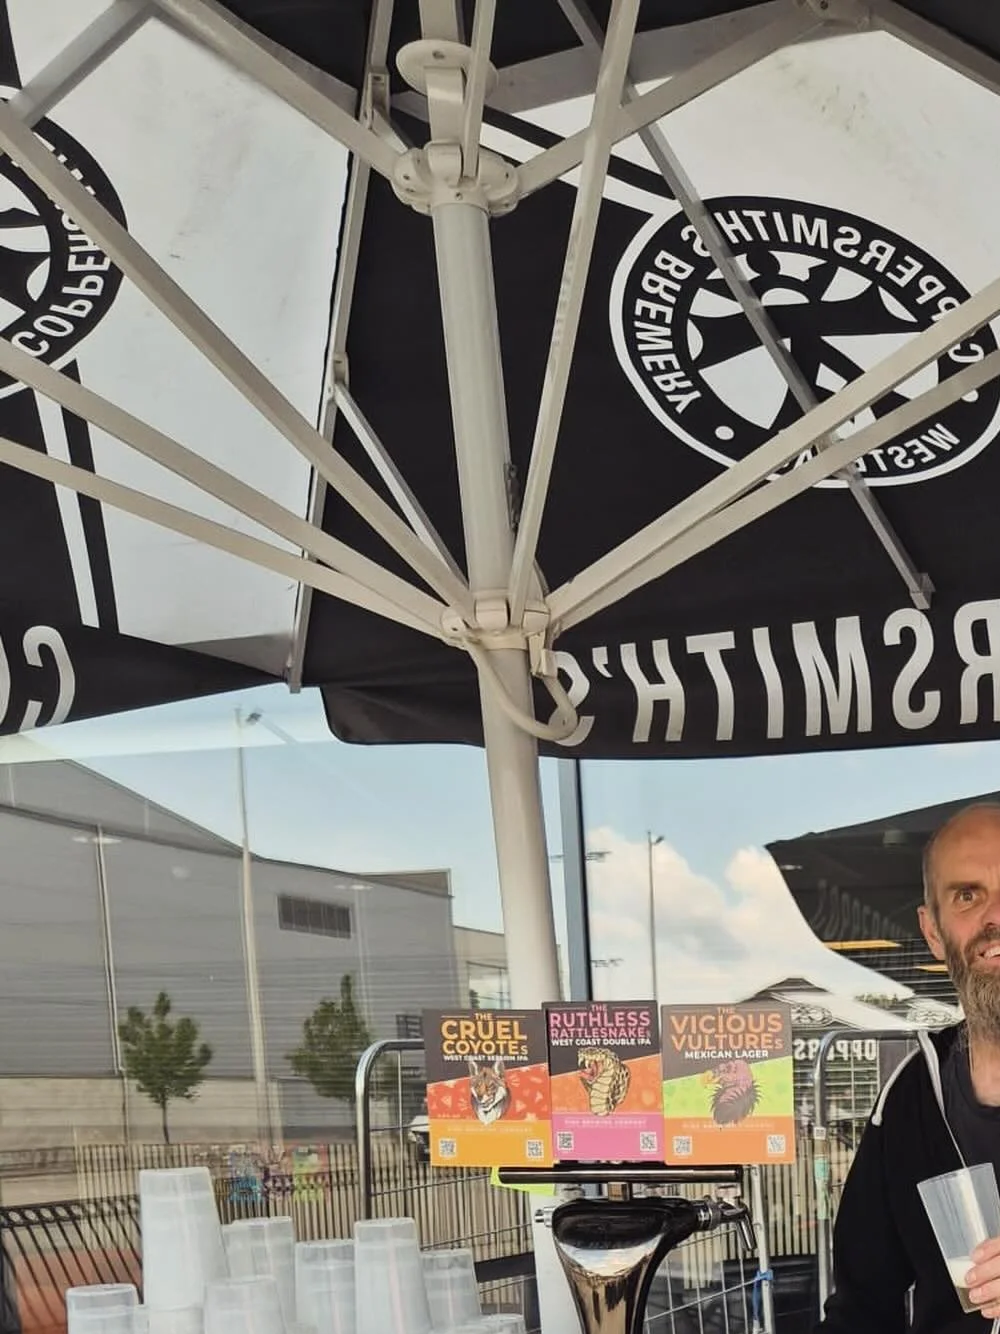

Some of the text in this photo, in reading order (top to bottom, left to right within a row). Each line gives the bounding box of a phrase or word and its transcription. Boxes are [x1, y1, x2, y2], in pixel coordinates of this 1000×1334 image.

[591, 1004, 607, 1012] THE
[474, 1013, 493, 1021] THE
[550, 1011, 650, 1027] RUTHLESS
[670, 1013, 783, 1034] VICIOUS
[441, 1020, 527, 1041] CRUEL
[552, 1038, 573, 1046] WEST
[575, 1038, 600, 1046] COAST
[603, 1038, 635, 1046] DOUBLE
[684, 1050, 769, 1059] MEXICAN LAGER
